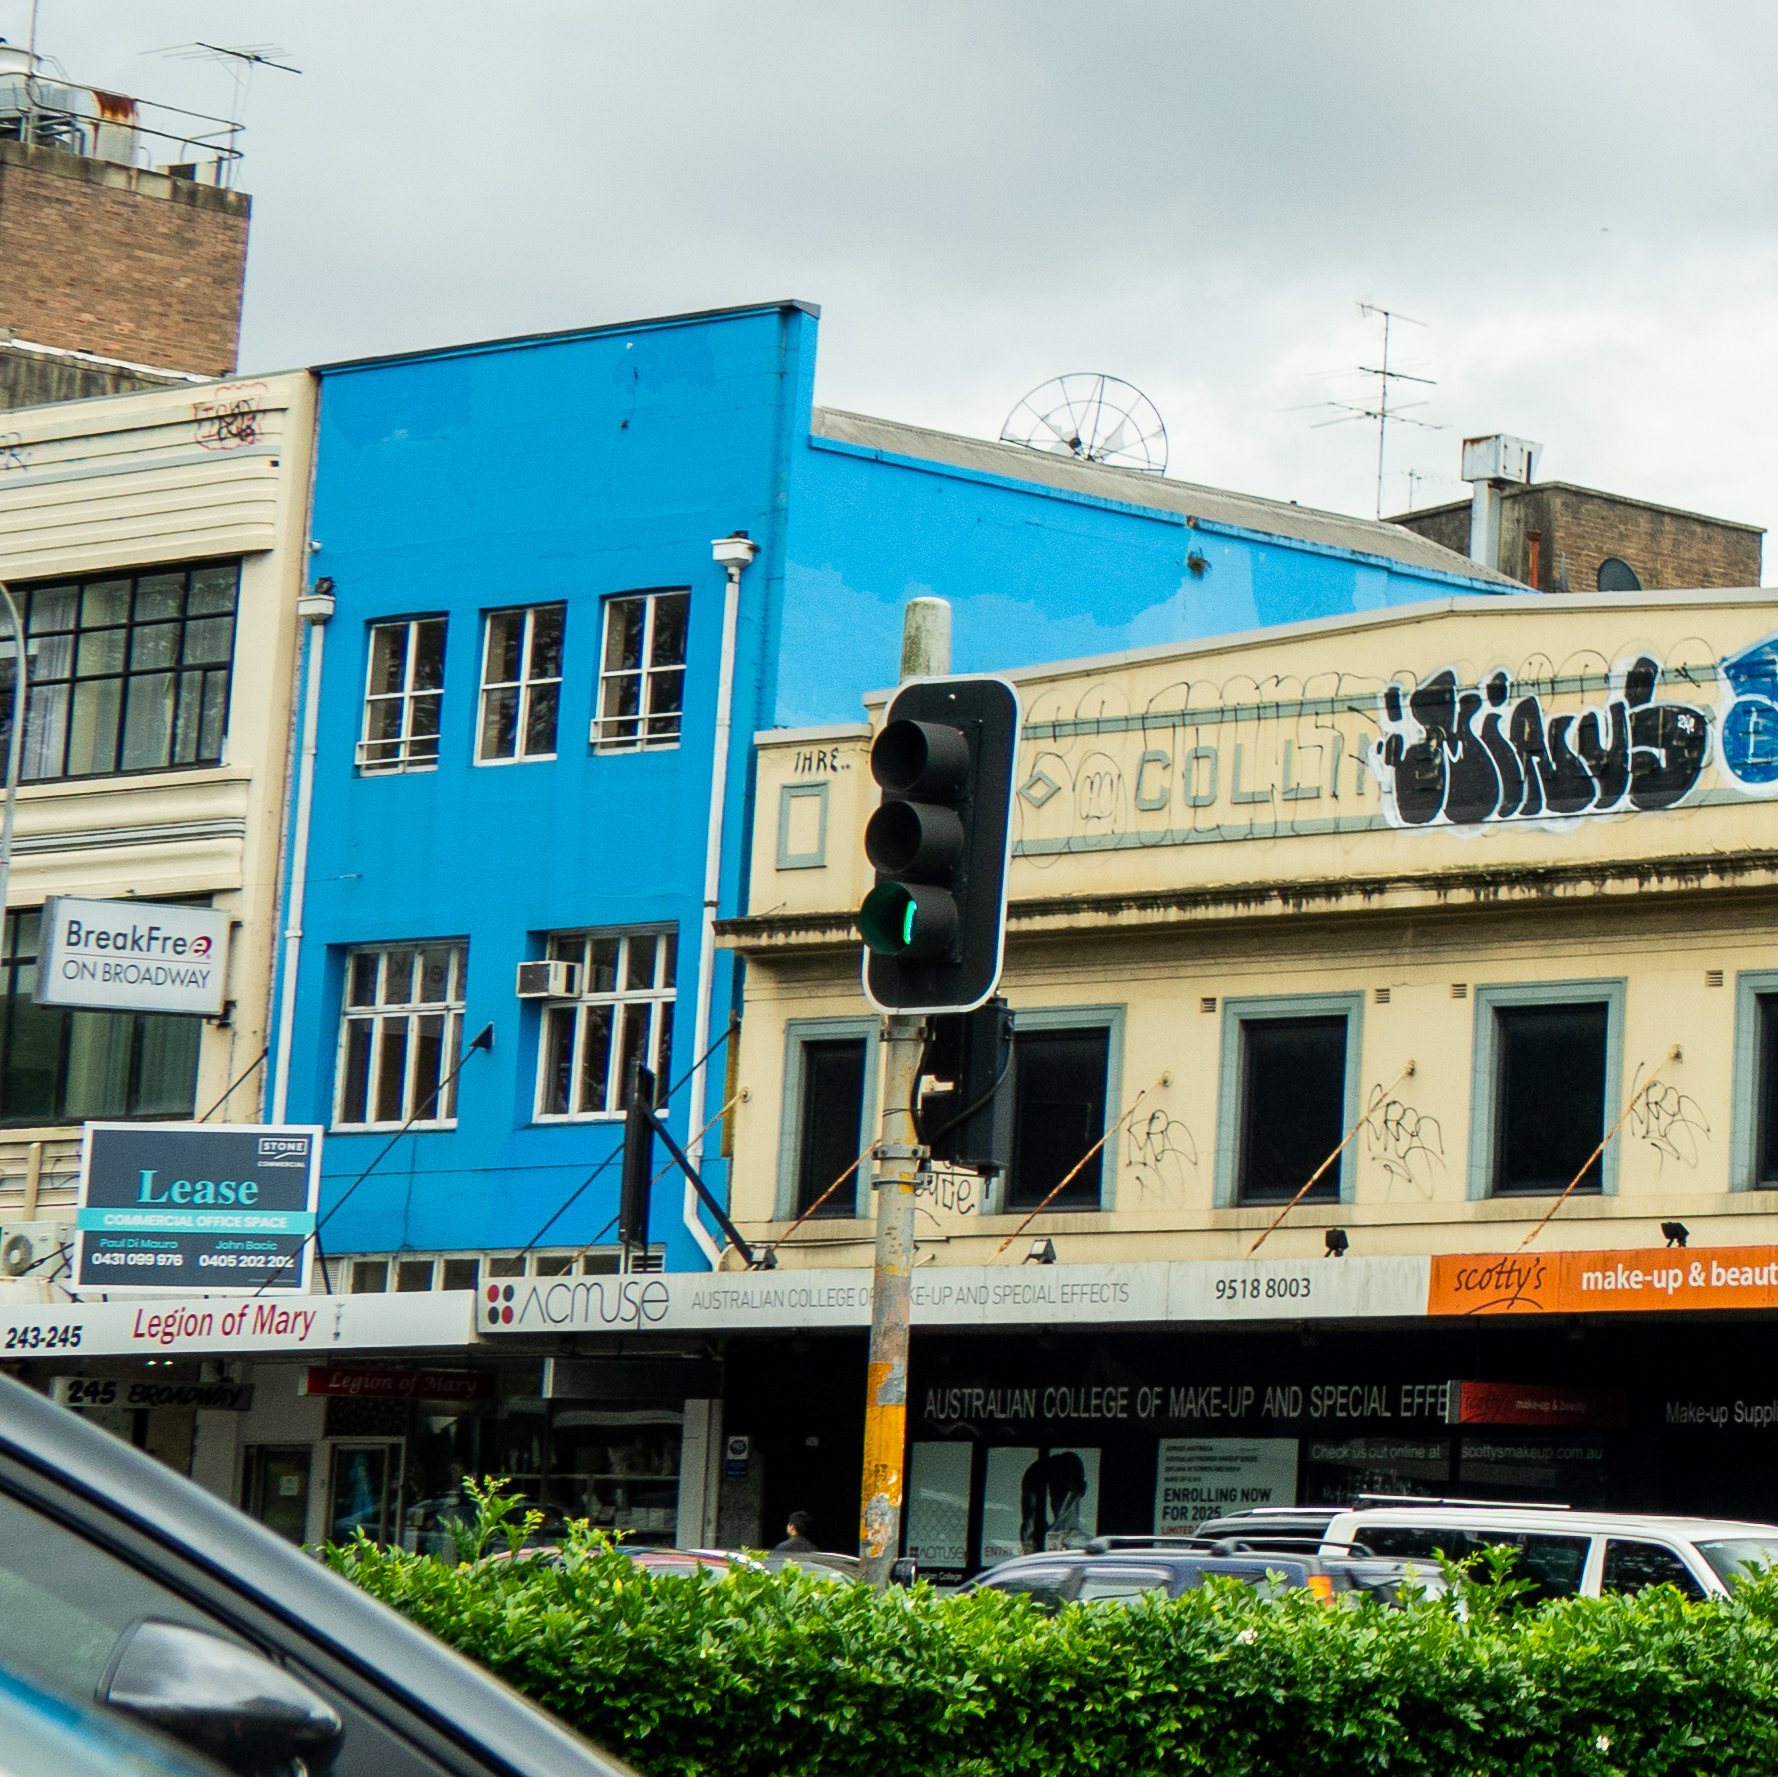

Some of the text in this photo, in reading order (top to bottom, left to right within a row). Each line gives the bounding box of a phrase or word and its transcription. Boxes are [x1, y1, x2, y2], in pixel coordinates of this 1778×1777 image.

[66, 919, 212, 959] BreakFree
[63, 960, 211, 989] ON BROADWAY
[263, 1140, 304, 1153] STONE
[136, 1169, 259, 1205] Lease
[103, 1214, 288, 1229] COMMERCIAL OFFICE SPACE
[215, 1240, 244, 1250] John
[91, 1253, 126, 1266] 0431
[156, 1254, 184, 1267] 976
[199, 1254, 267, 1268] 0405 202
[1581, 1264, 1683, 1296] make-up
[1688, 1262, 1707, 1288] &
[691, 1277, 1312, 1310] AUSTRALIAN COLLEGE AND SPECIAL EFFECTS 9518 8003
[4, 1303, 317, 1350] 243-245 Legion of Mary
[66, 1379, 245, 1408] 245 BROADWAY
[327, 1371, 478, 1399] Legion of Mary
[923, 1385, 1392, 1420] AUSTRALIAN COLLEGE OF MAKE-UP AND SPECIAL
[1665, 1400, 1730, 1428] Make-up
[1311, 1444, 1349, 1459] Check
[1351, 1447, 1367, 1459] us
[1368, 1446, 1388, 1459] out
[1163, 1487, 1272, 1503] ENROLLING NOW
[1162, 1505, 1222, 1521] FOR 2025
